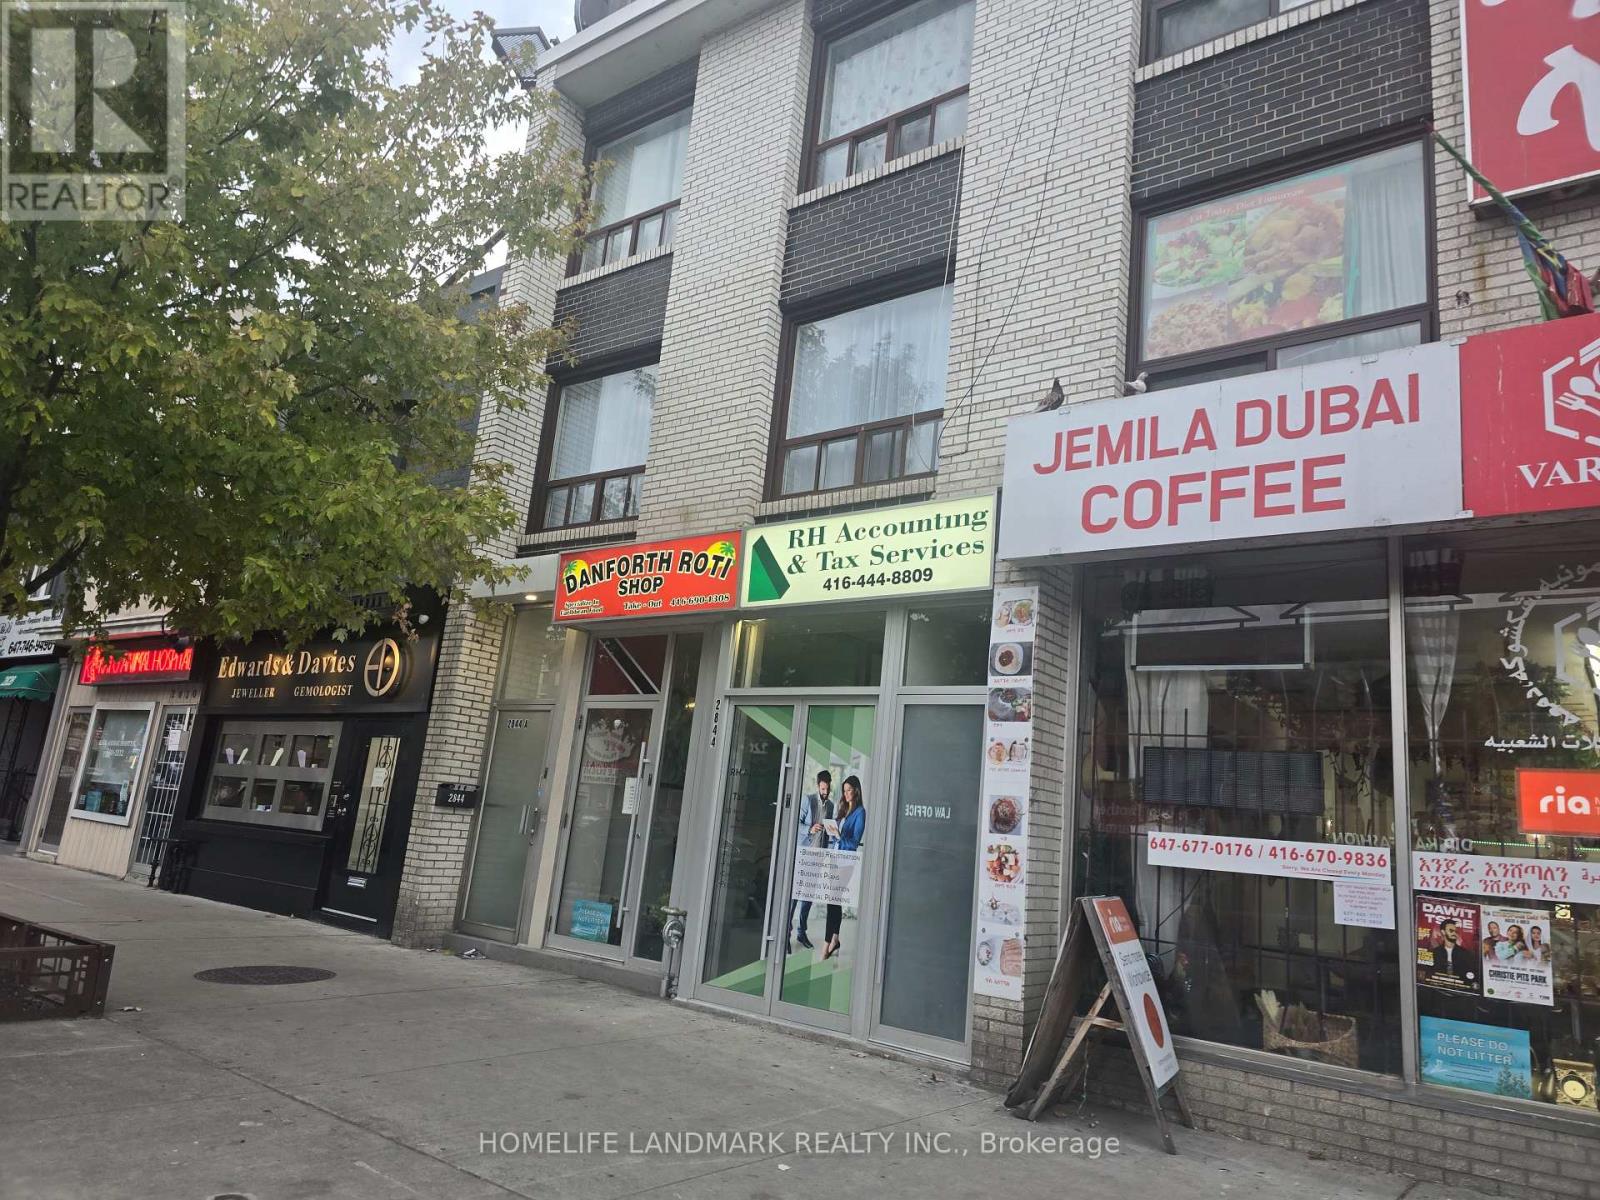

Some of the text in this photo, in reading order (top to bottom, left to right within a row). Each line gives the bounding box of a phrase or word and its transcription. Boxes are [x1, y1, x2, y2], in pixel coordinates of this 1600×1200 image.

[1033, 373, 1421, 475] JEMILA DUBAI
[1080, 454, 1347, 535] COFFEE
[787, 509, 989, 549] RH Accounting
[787, 538, 985, 575] & Tax Services
[564, 550, 734, 595] DANFORTH ROTI
[617, 576, 664, 596] SHOP
[822, 567, 934, 591] 416-444-8809
[624, 601, 642, 611] Take
[648, 600, 663, 610] Out
[217, 653, 283, 679] Edwards
[297, 649, 356, 675] Davies
[231, 684, 354, 699] JEWELLER GEMOLOGIST
[711, 699, 720, 747] 2844
[447, 793, 465, 804] 2844
[1539, 785, 1591, 815] ria
[1149, 836, 1254, 858] 647-677-0176
[1268, 847, 1388, 868] 416-670-9836
[1422, 902, 1476, 919] DAWIT
[1488, 969, 1516, 980] CHRISTIE
[1515, 973, 1530, 982] PITS
[1530, 974, 1547, 984] PARK
[1437, 1032, 1508, 1051] PLEASE DO
[1437, 1046, 1513, 1066] NOT LITTER
